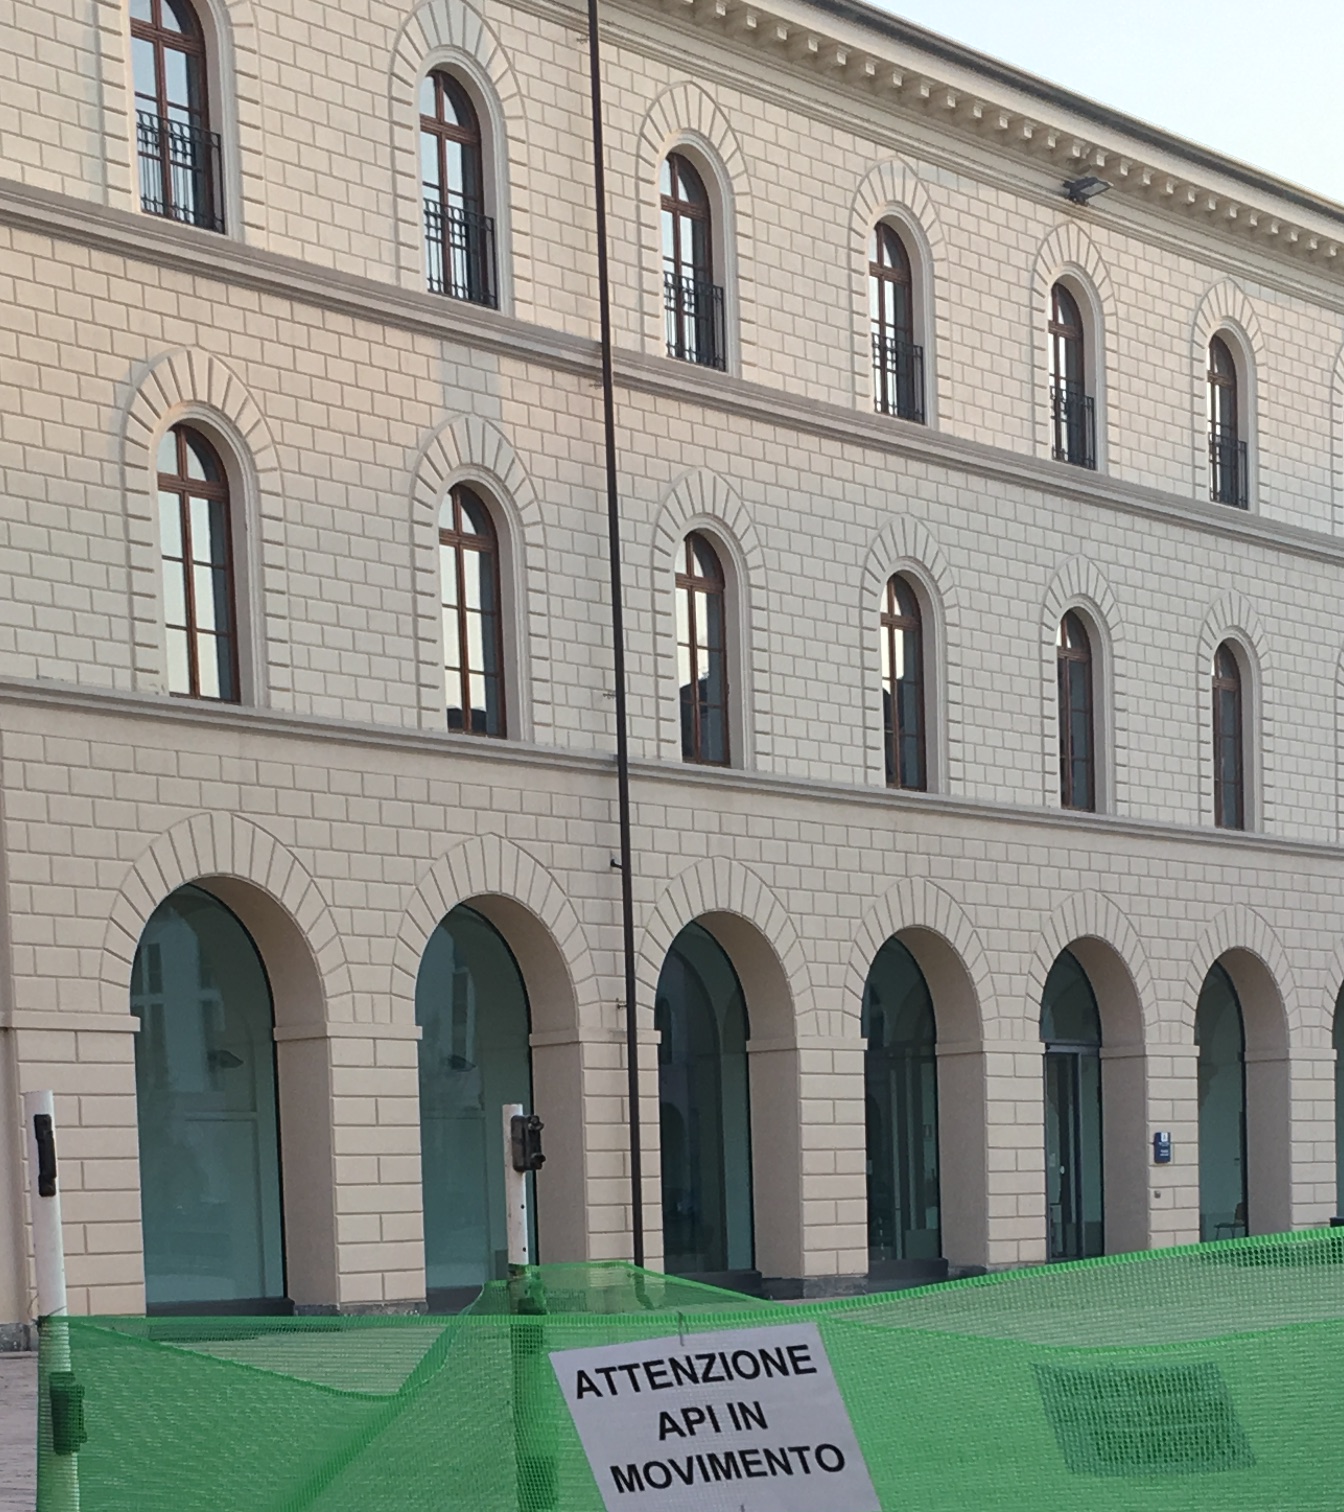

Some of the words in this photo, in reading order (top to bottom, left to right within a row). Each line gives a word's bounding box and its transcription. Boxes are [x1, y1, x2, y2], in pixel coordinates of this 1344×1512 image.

[576, 1344, 817, 1399] ATTENZIONE
[659, 1405, 721, 1441] API
[727, 1401, 768, 1431] IN
[610, 1443, 845, 1493] MOVIMENTO
